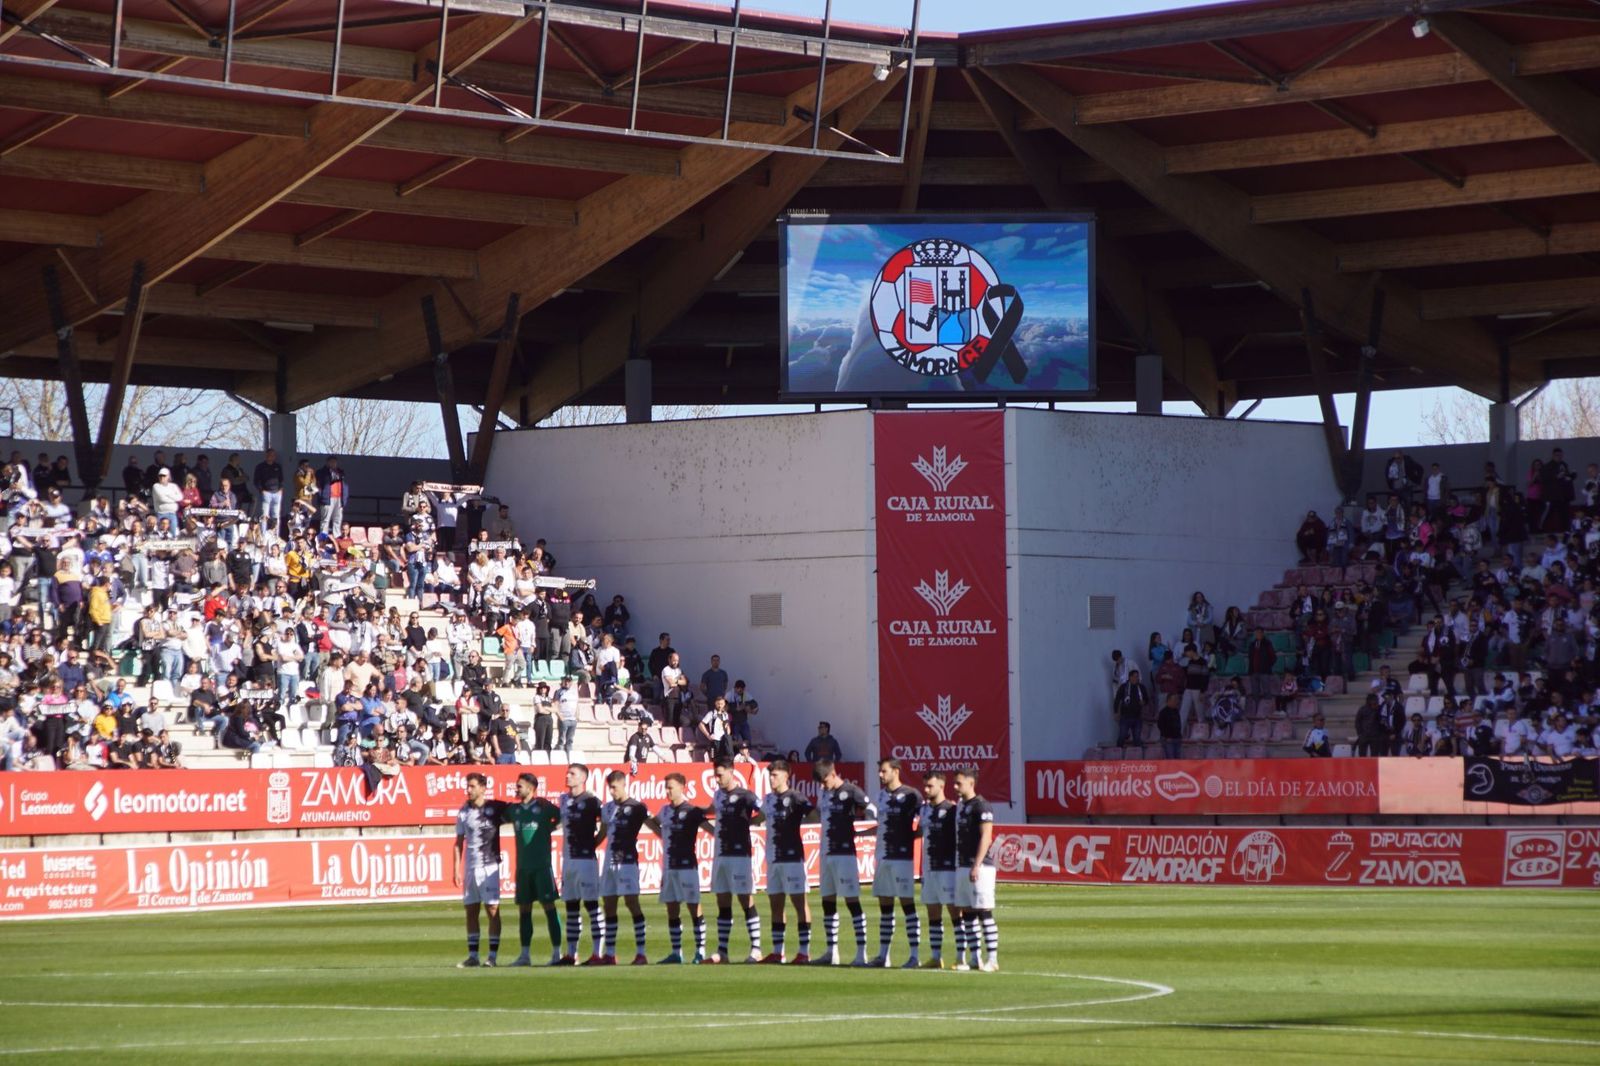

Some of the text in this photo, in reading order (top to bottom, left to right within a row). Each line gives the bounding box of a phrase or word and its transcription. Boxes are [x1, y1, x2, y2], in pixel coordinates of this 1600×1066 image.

[886, 346, 959, 375] ZAMORA
[887, 496, 994, 511] CAJA RURAL
[906, 513, 975, 522] DE ZAMORA
[889, 620, 996, 635] CAJA RURAL
[908, 637, 977, 646] DE ZAMORA
[892, 745, 998, 760] CAJA RURAL
[911, 763, 927, 772] DE
[1037, 768, 1151, 811] Melquiades
[1225, 777, 1377, 796] EL DÍA DE ZAMORA
[20, 790, 48, 803] Grupo
[114, 787, 247, 813] leomotor.net
[20, 802, 75, 815] Leomotor
[300, 810, 371, 822] AYUNTAMIENTO
[1126, 830, 1228, 855] FUNDACIÓN
[1515, 843, 1554, 854] ONDA
[1064, 835, 1111, 875] CF
[0, 858, 26, 880] ied
[311, 841, 443, 898] La Opinión
[1359, 860, 1466, 885] ZAMORA
[1516, 861, 1553, 873] CERO
[126, 848, 268, 906] La Opinión
[6, 882, 97, 899] Arquitectura
[321, 883, 429, 897] El Correo de Zamora
[137, 890, 253, 906] El Correo de Zamora
[0, 901, 24, 912] .com
